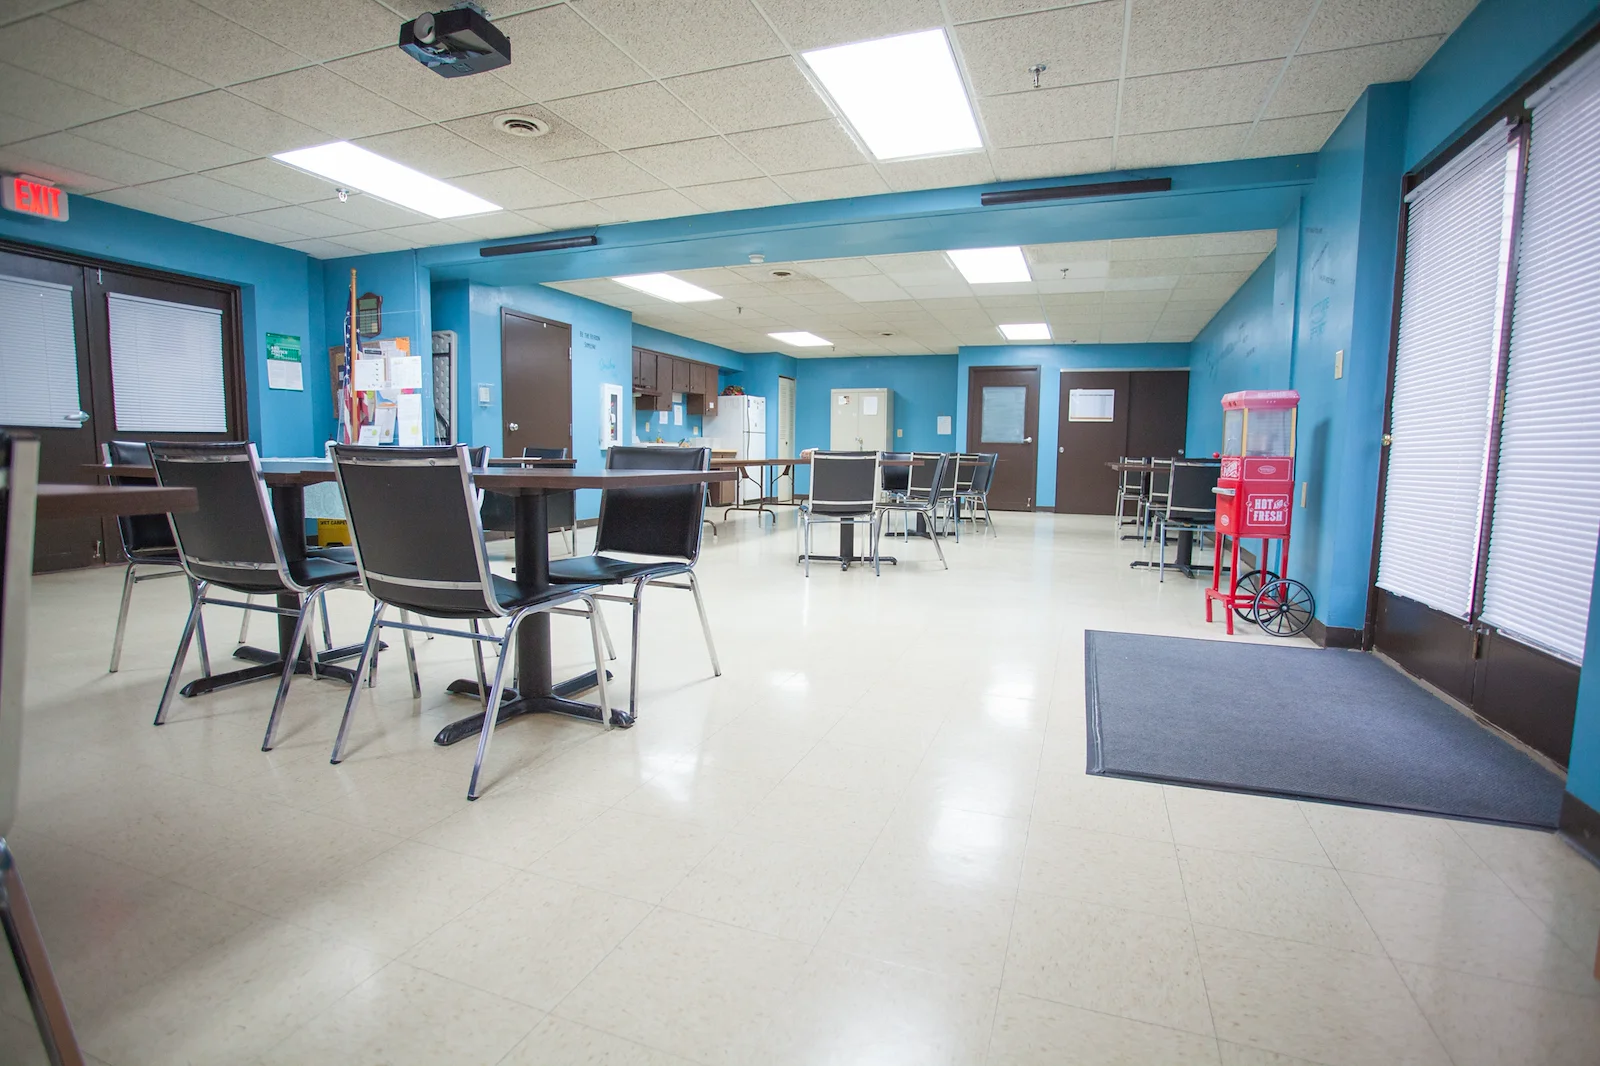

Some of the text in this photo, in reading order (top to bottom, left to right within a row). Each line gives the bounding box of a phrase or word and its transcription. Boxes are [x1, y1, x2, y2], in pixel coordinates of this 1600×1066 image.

[15, 178, 61, 217] EXIT
[1254, 498, 1274, 510] HOT
[1253, 510, 1283, 522] FRESH
